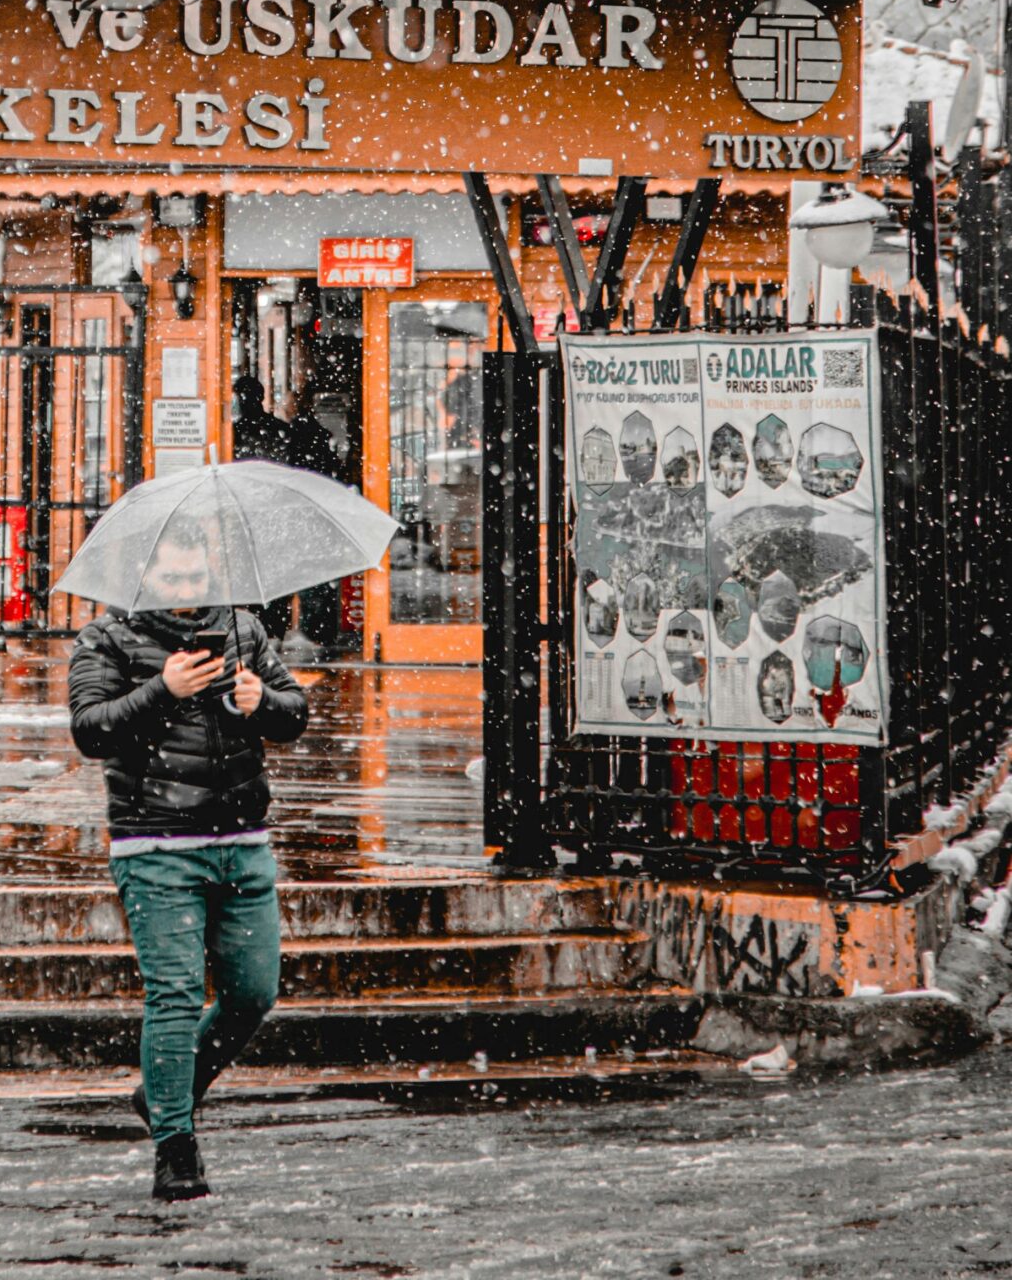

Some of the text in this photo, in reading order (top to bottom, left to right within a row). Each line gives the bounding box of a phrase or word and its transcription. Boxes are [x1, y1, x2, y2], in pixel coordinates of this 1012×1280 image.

[704, 133, 855, 171] TURYOL
[326, 265, 409, 284] ANTRE
[639, 358, 681, 386] TURU
[726, 346, 817, 379] ADALAR
[676, 392, 699, 403] TOUR
[726, 380, 768, 393] PRINCES
